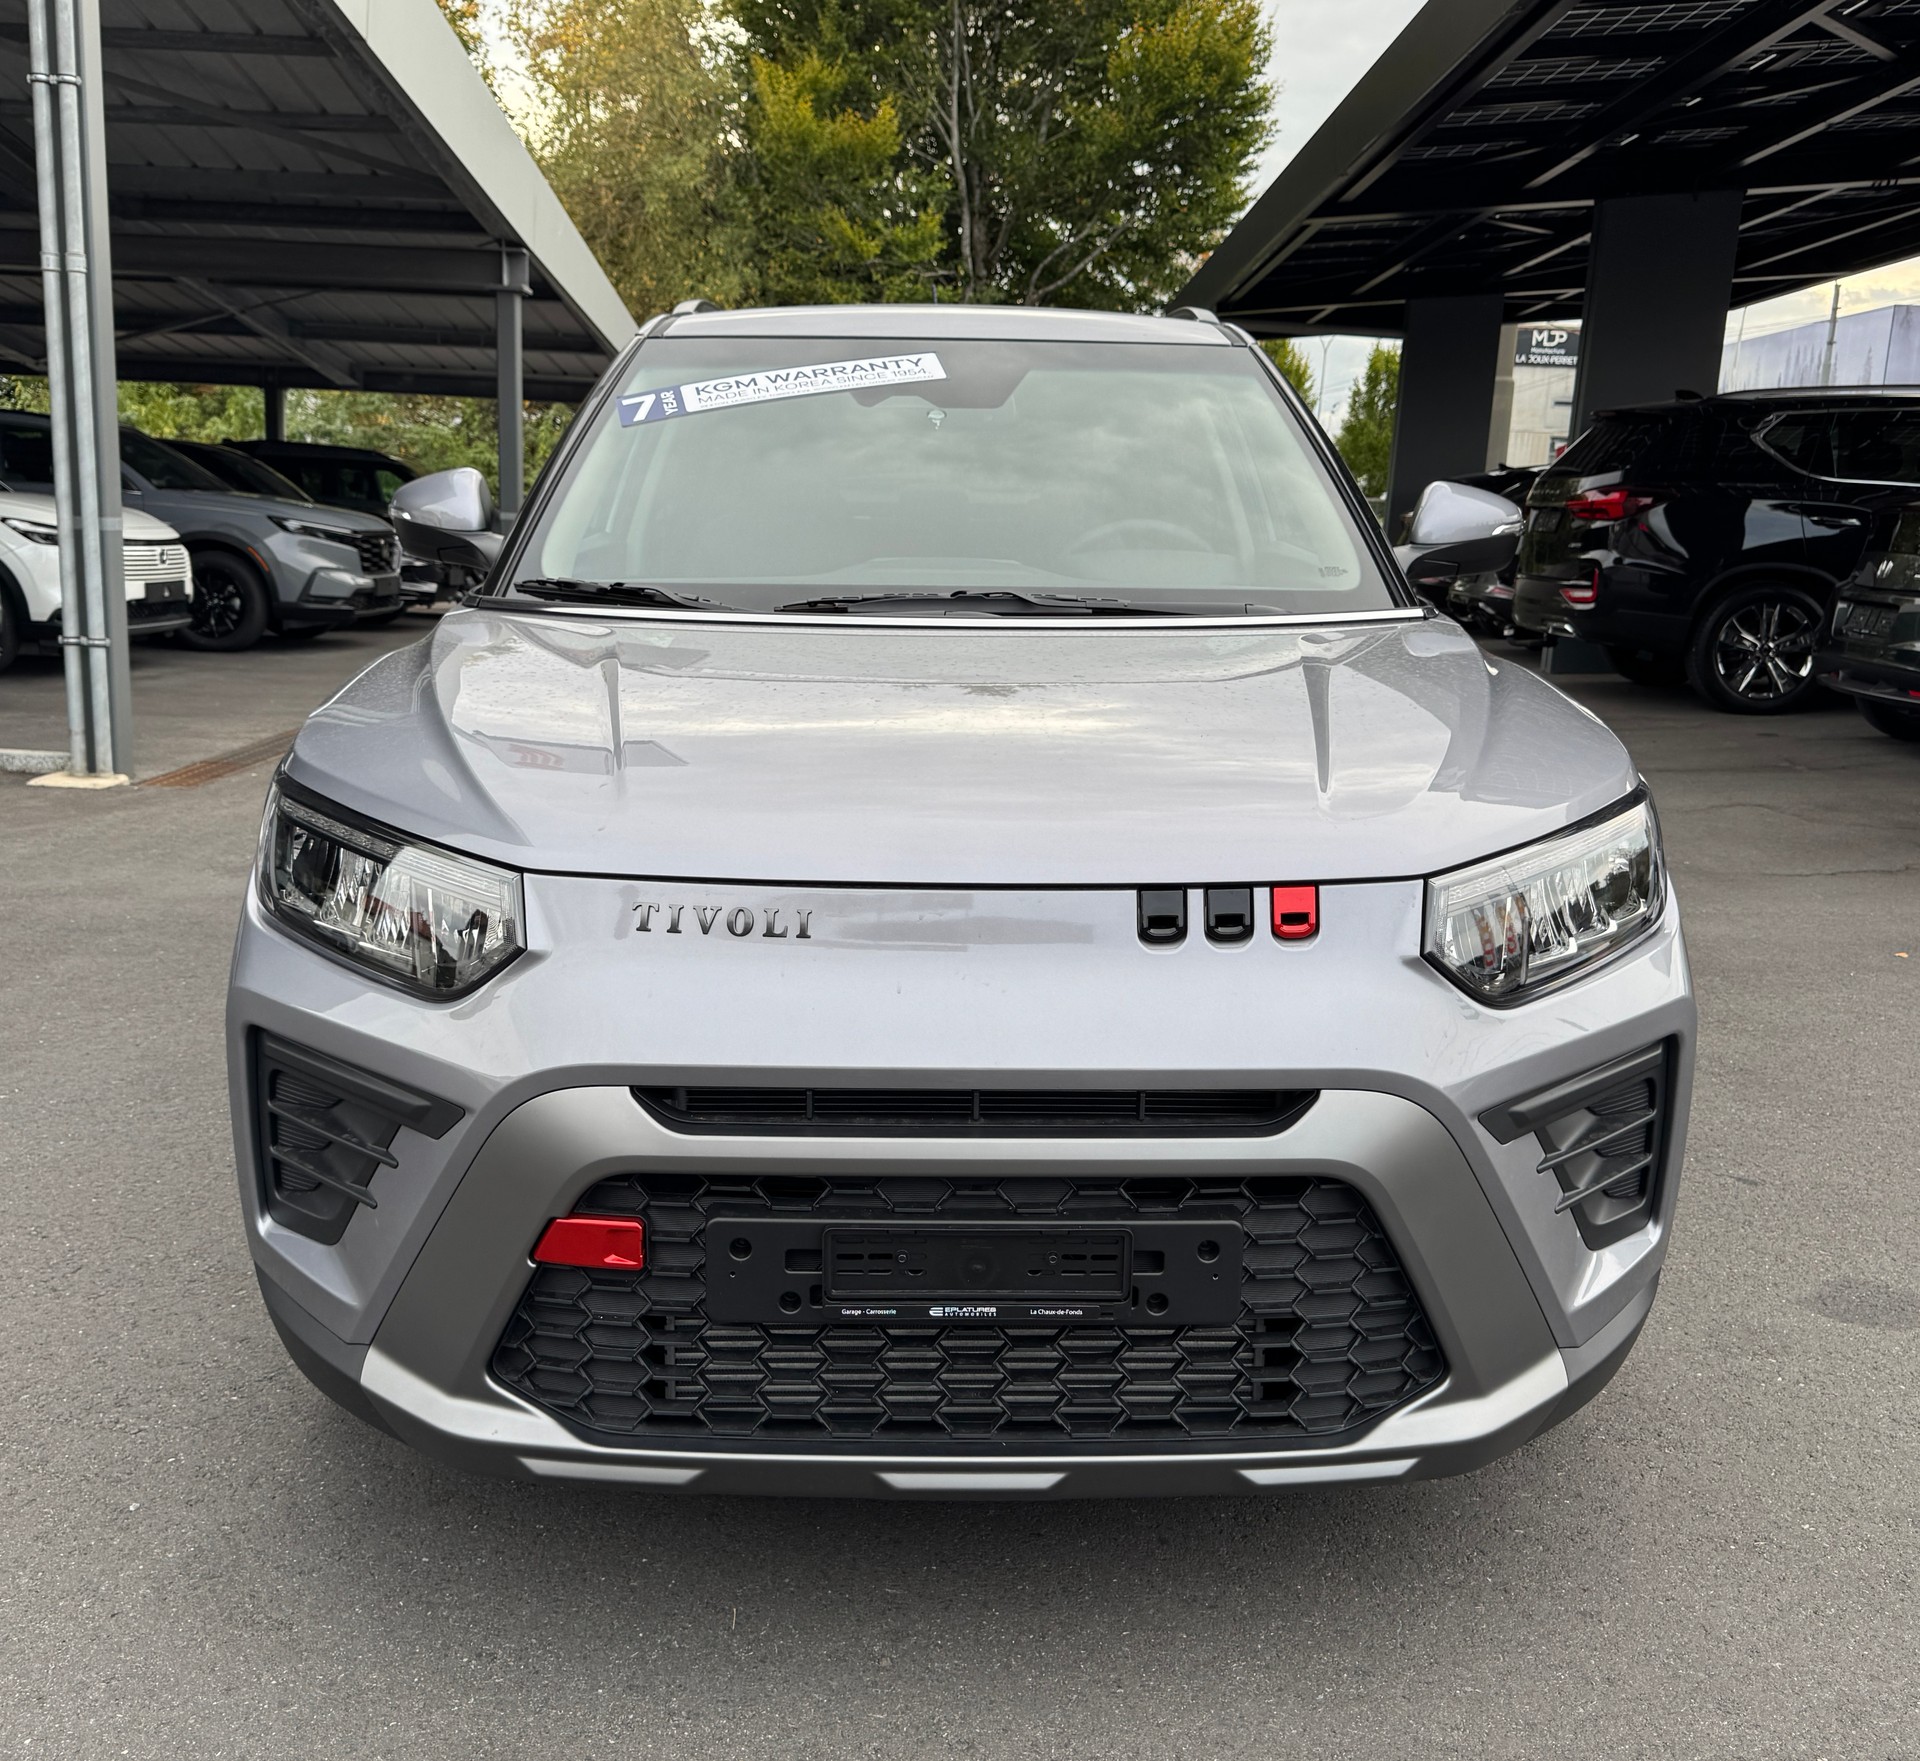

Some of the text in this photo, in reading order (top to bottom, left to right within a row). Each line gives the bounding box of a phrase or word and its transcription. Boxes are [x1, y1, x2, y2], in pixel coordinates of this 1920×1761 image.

[1515, 353, 1527, 364] LA
[695, 377, 758, 396] KGM
[765, 357, 922, 384] WARRANTY
[698, 389, 748, 404] MADE
[752, 386, 770, 396] IN
[775, 378, 833, 392] KOREA
[836, 370, 888, 385] SINCE
[621, 393, 657, 422] 7
[660, 390, 679, 416] YEAR
[632, 901, 813, 939] TIVOLI
[841, 1308, 862, 1316] Garage
